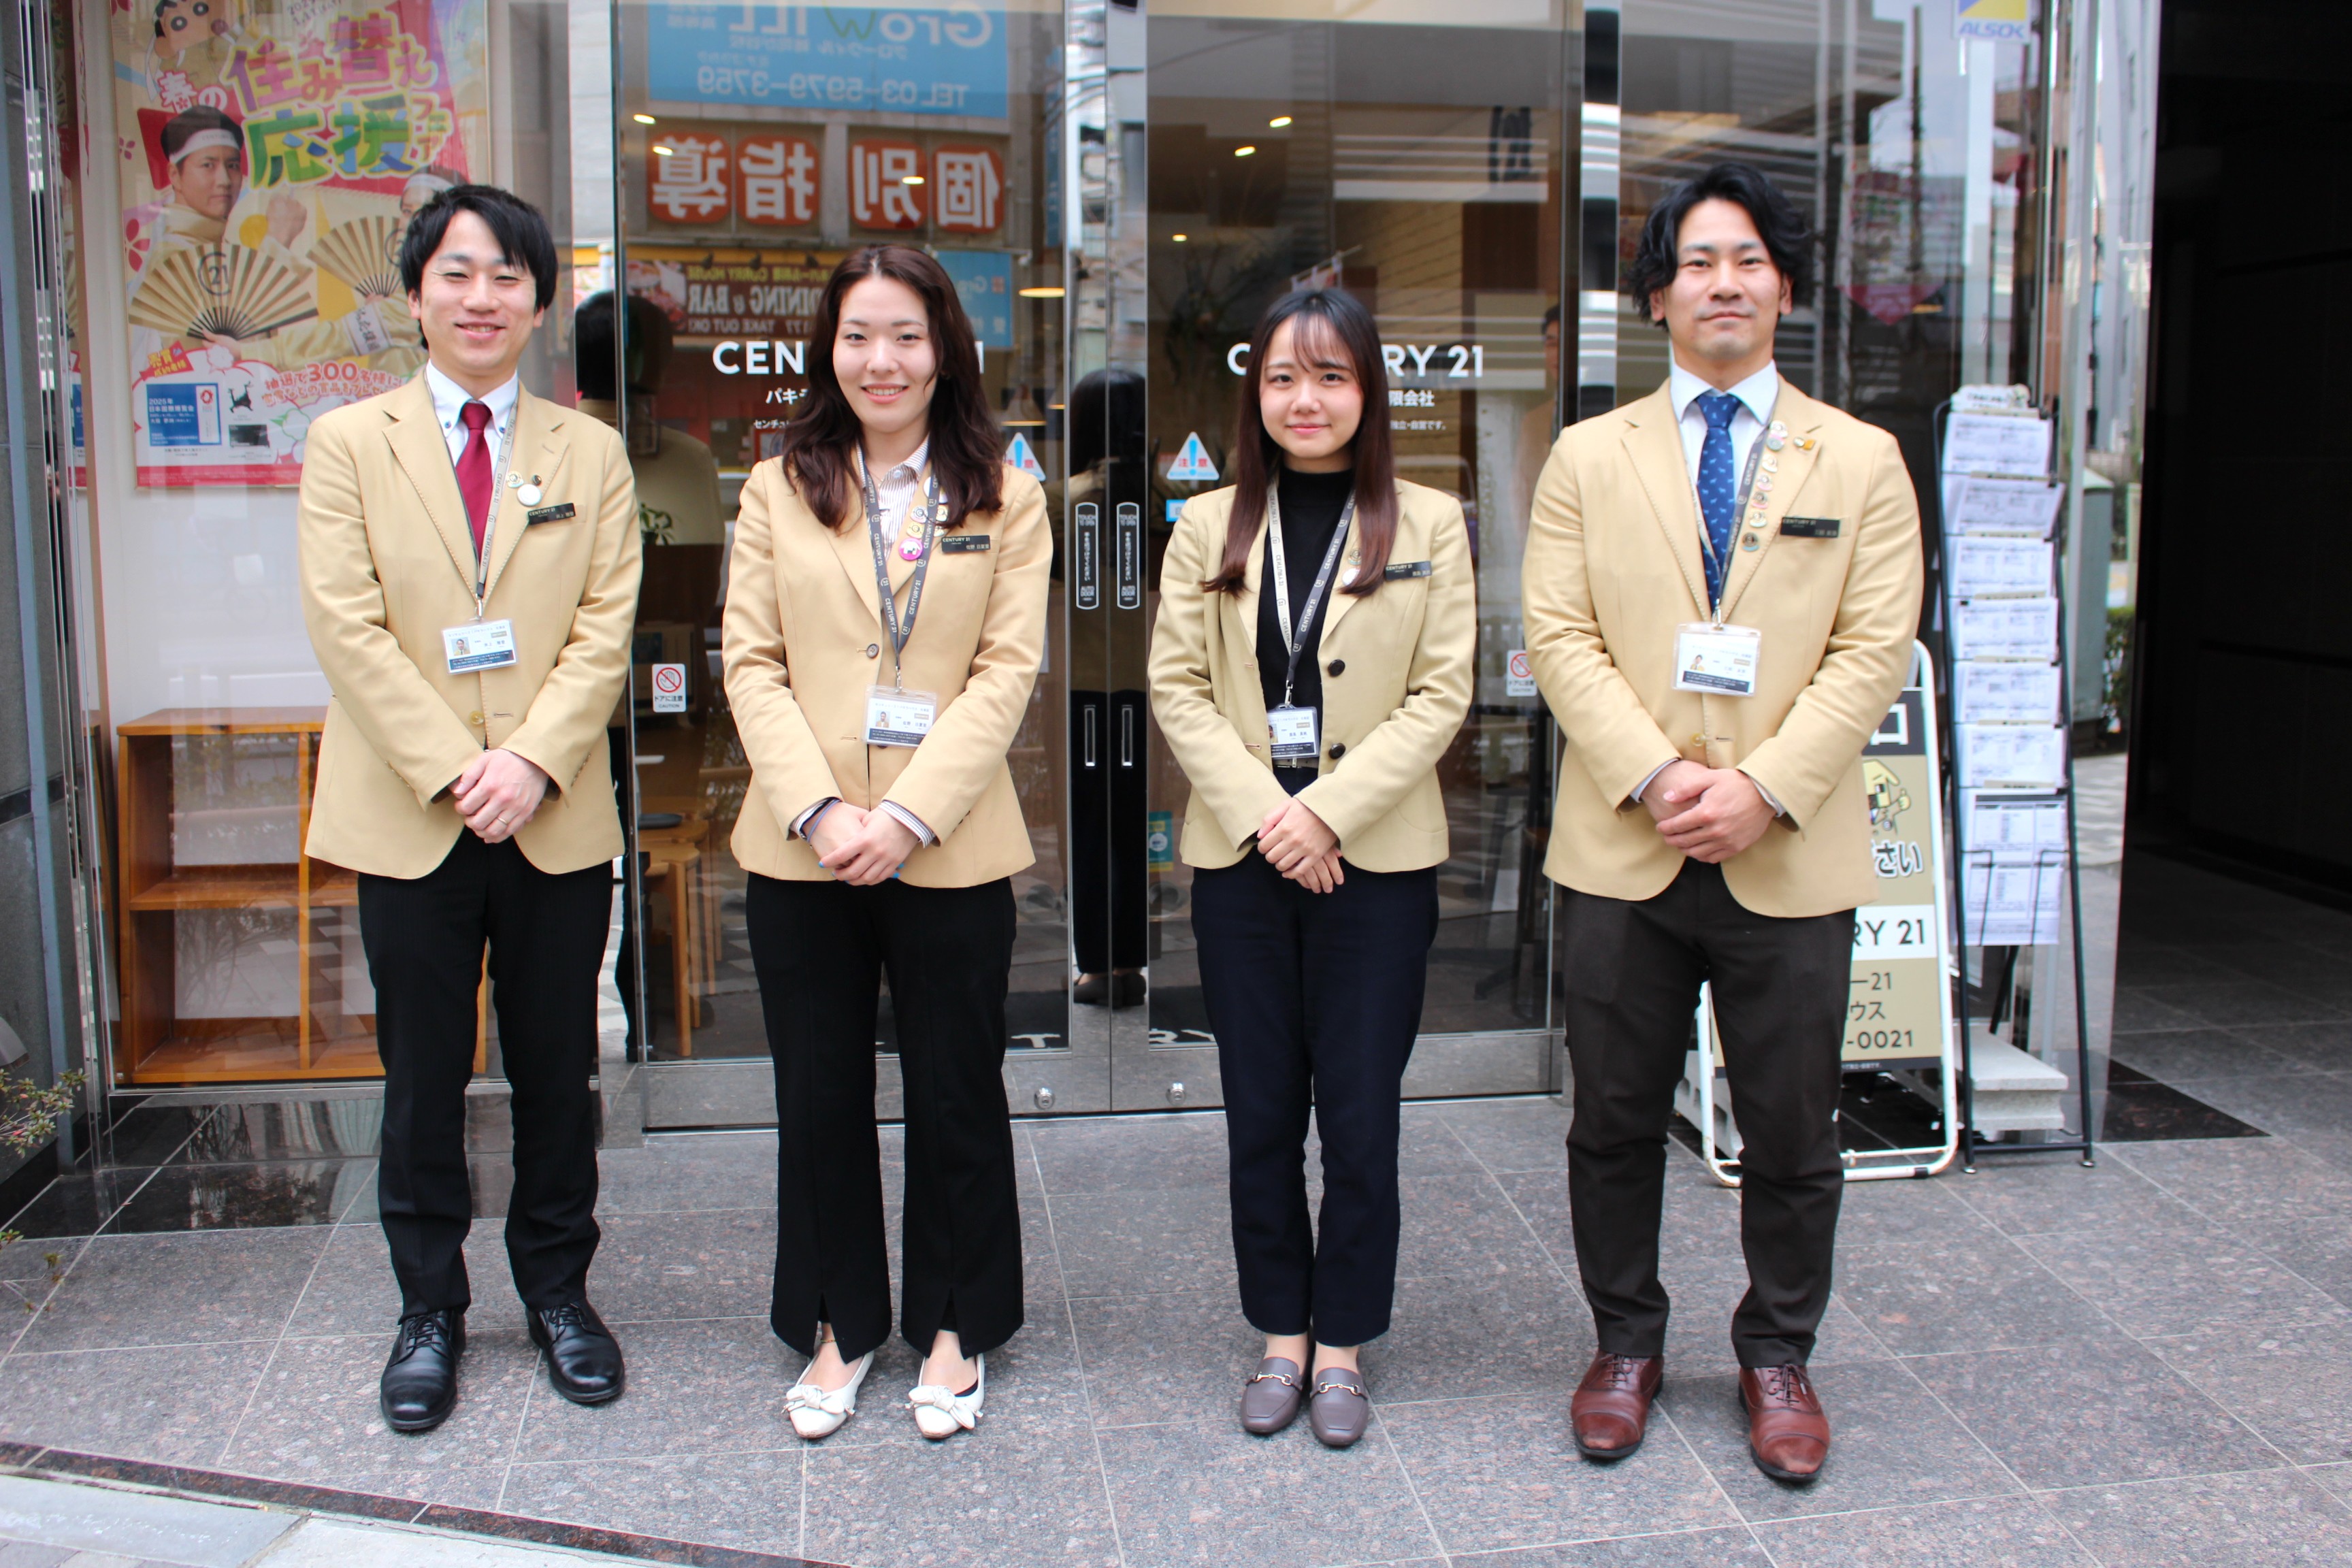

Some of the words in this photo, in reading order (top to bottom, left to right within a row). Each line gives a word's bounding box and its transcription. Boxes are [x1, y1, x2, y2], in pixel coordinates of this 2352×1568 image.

[1959, 21, 2025, 39] ALSOK
[227, 12, 431, 113] 住み替え
[160, 71, 227, 113] 春の
[247, 94, 413, 189] 応援
[713, 341, 805, 374] CEN
[1448, 345, 1484, 378] 21
[529, 508, 550, 517] CENTURY
[874, 532, 882, 559] CENTURY
[923, 524, 932, 549] CENTURY
[1324, 544, 1338, 570] CENTURY
[885, 598, 895, 625] CENTURY
[909, 586, 919, 615] CENTURY
[1301, 605, 1314, 632] CENTURY
[1875, 842, 1923, 875] さい
[1897, 919, 1925, 945] 21
[1850, 1001, 1886, 1021] ウス
